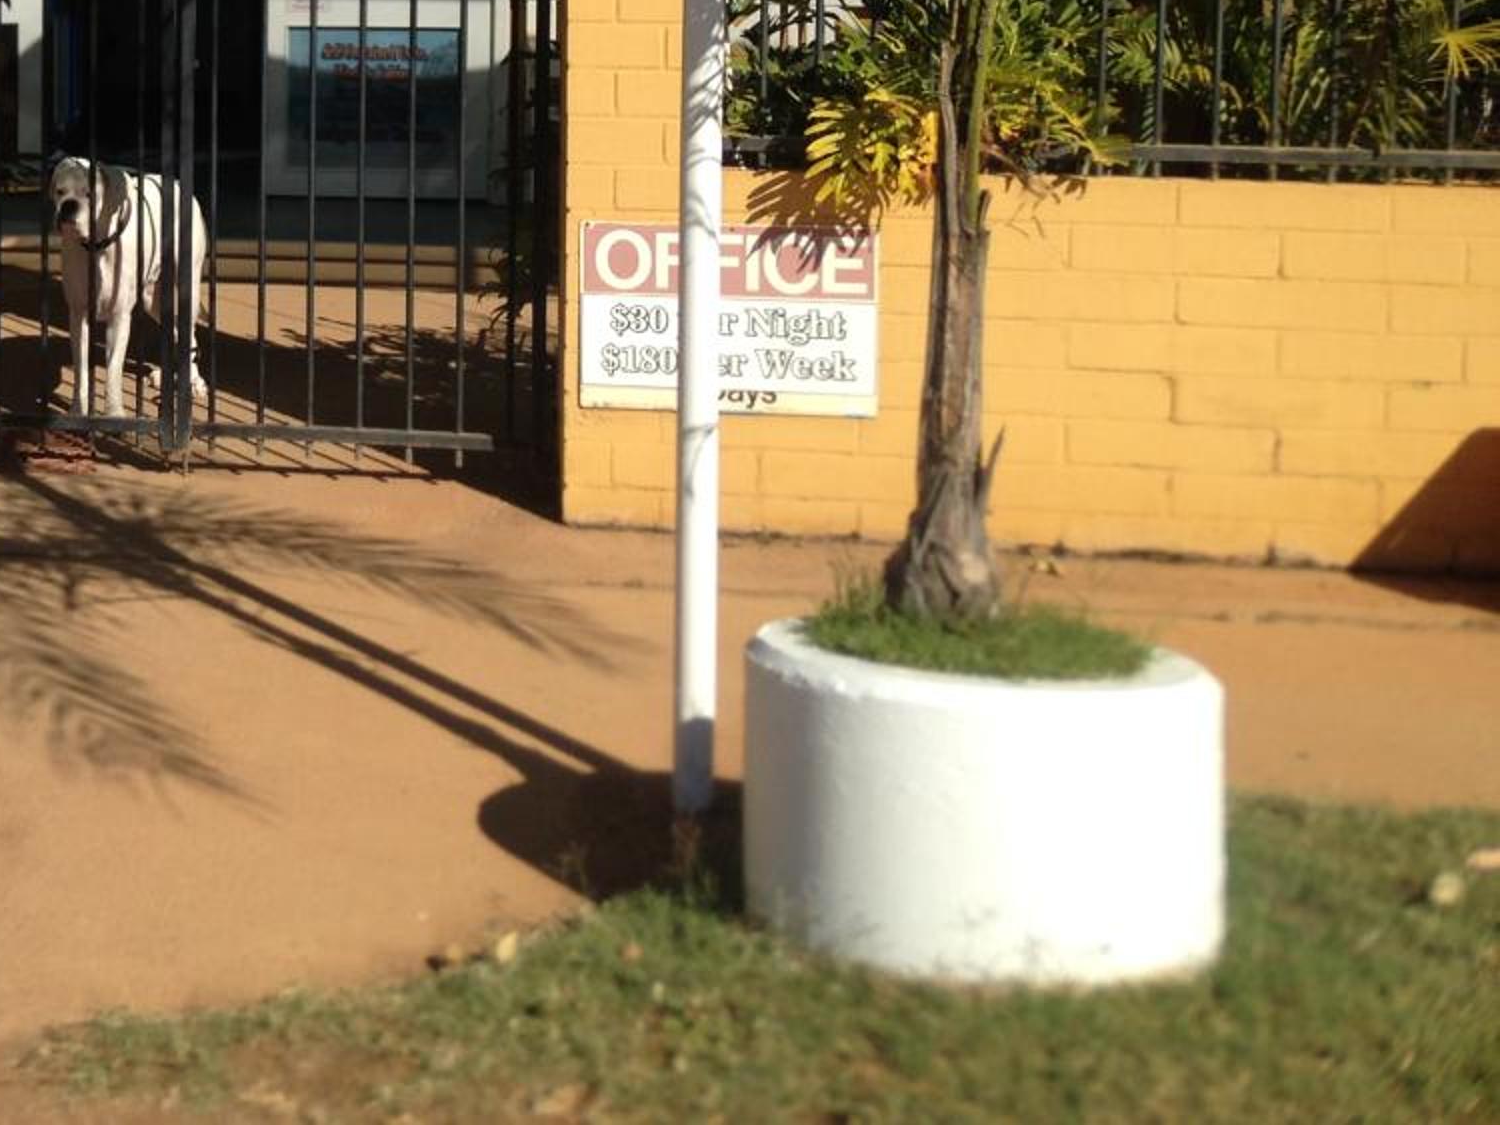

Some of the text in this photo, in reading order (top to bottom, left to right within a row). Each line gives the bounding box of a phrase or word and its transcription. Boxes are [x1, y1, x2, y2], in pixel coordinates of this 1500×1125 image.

[609, 302, 669, 338] $30
[743, 306, 848, 346] Night
[600, 342, 678, 378] $180
[753, 348, 858, 382] Week
[717, 389, 778, 409] ays
